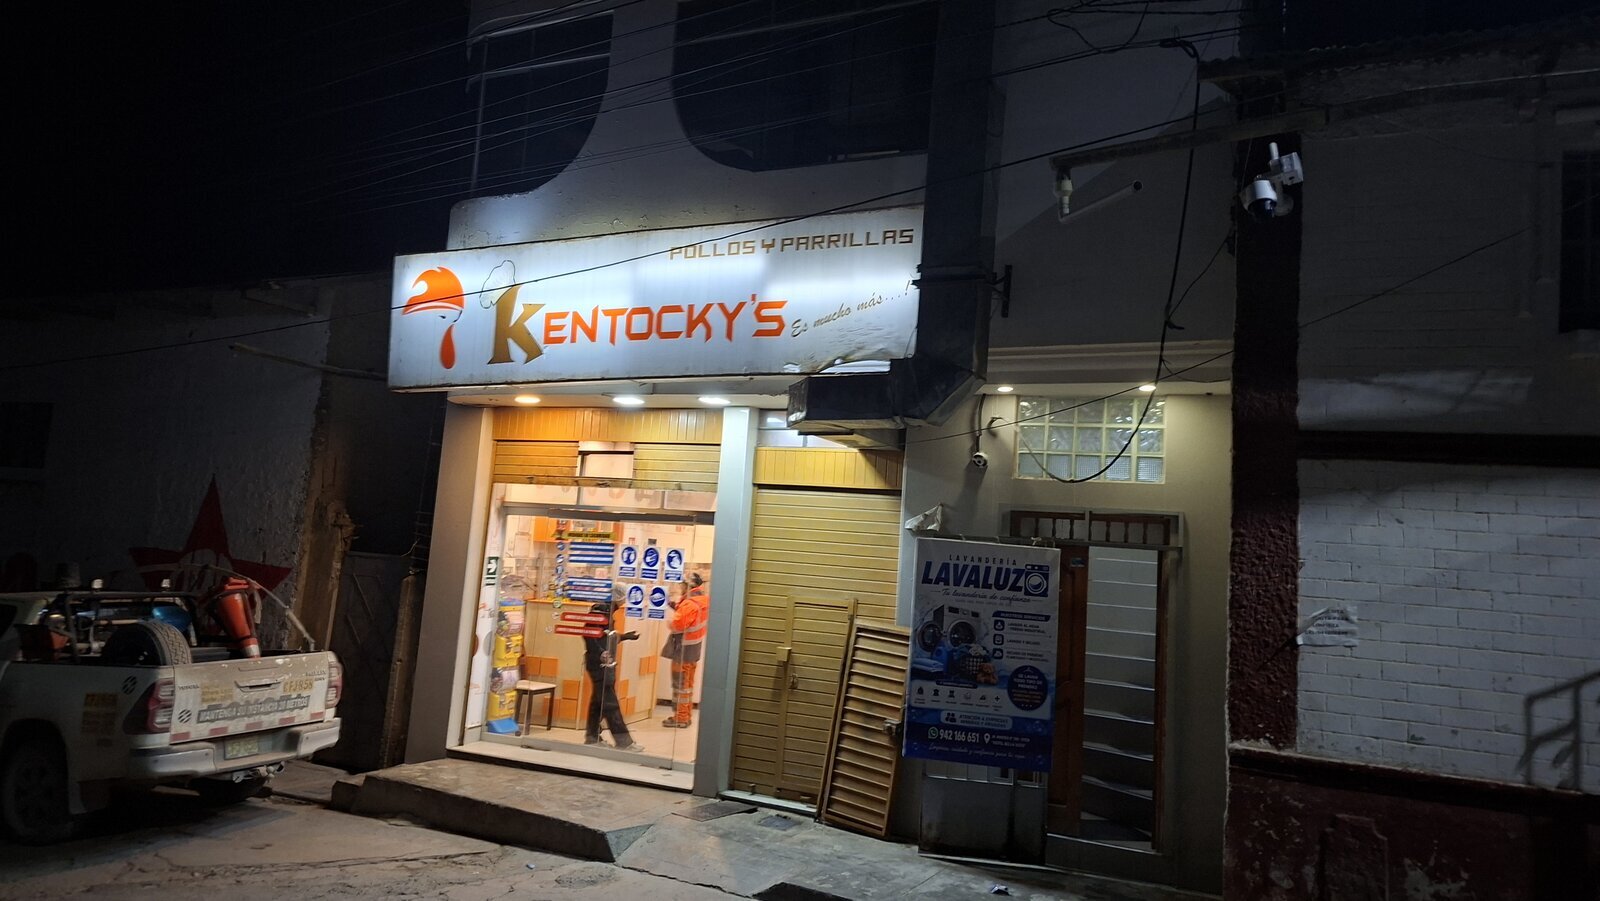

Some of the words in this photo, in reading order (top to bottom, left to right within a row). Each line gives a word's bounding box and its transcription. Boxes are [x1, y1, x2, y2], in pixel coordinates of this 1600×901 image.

[670, 241, 755, 260] POLLOS
[761, 238, 775, 254] Y
[780, 229, 914, 252] PARRILLAS
[791, 319, 808, 337] Es
[813, 303, 851, 328] mucho
[949, 554, 1017, 566] LAVANDERÍA
[939, 729, 953, 740] 942
[954, 730, 966, 742] 166
[967, 732, 979, 743] 651
